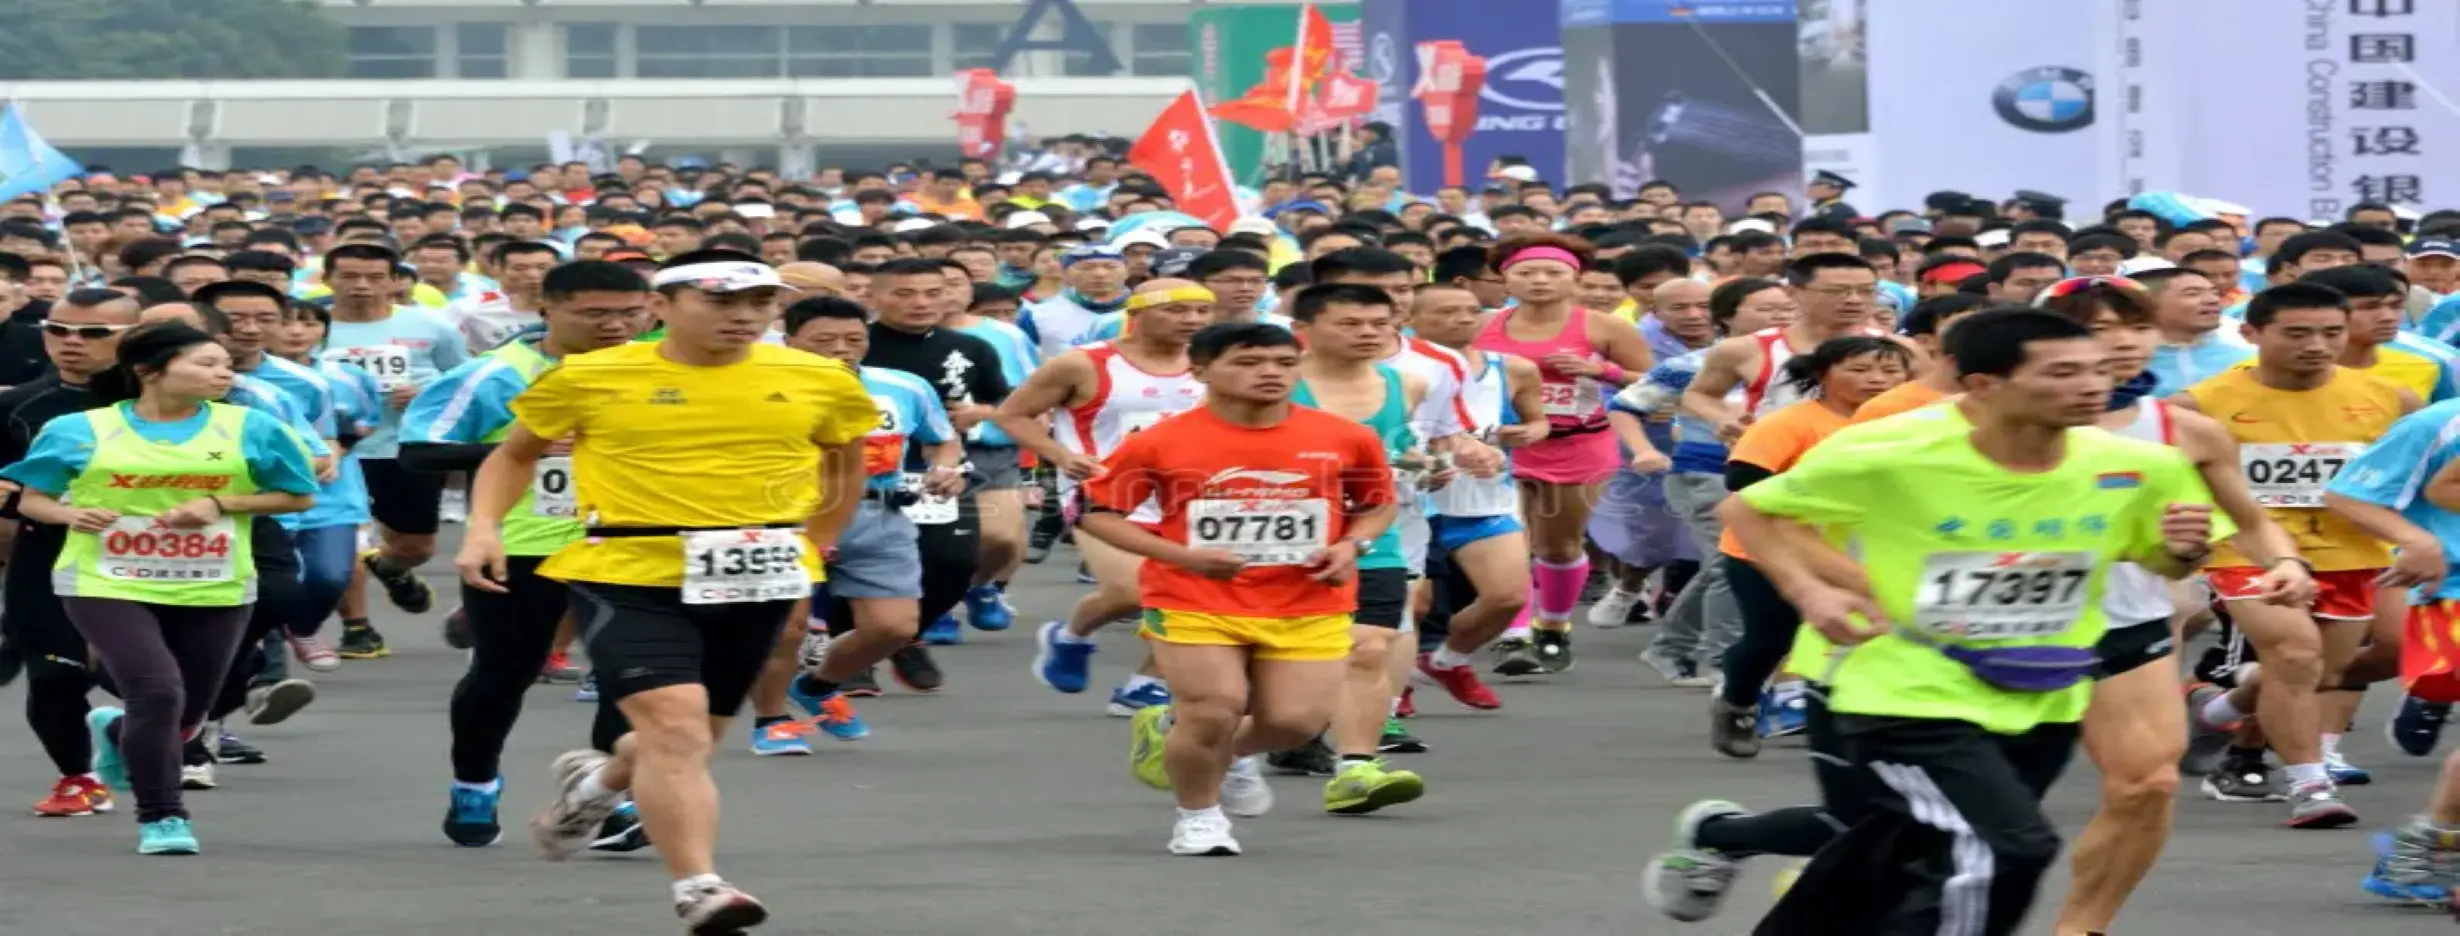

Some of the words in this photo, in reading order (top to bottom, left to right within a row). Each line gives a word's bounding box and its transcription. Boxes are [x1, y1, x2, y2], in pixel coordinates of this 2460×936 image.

[2306, 58, 2340, 192] Construction
[107, 530, 230, 558] 00384
[1199, 515, 1316, 541] 07781
[1935, 568, 2088, 606] 17397
